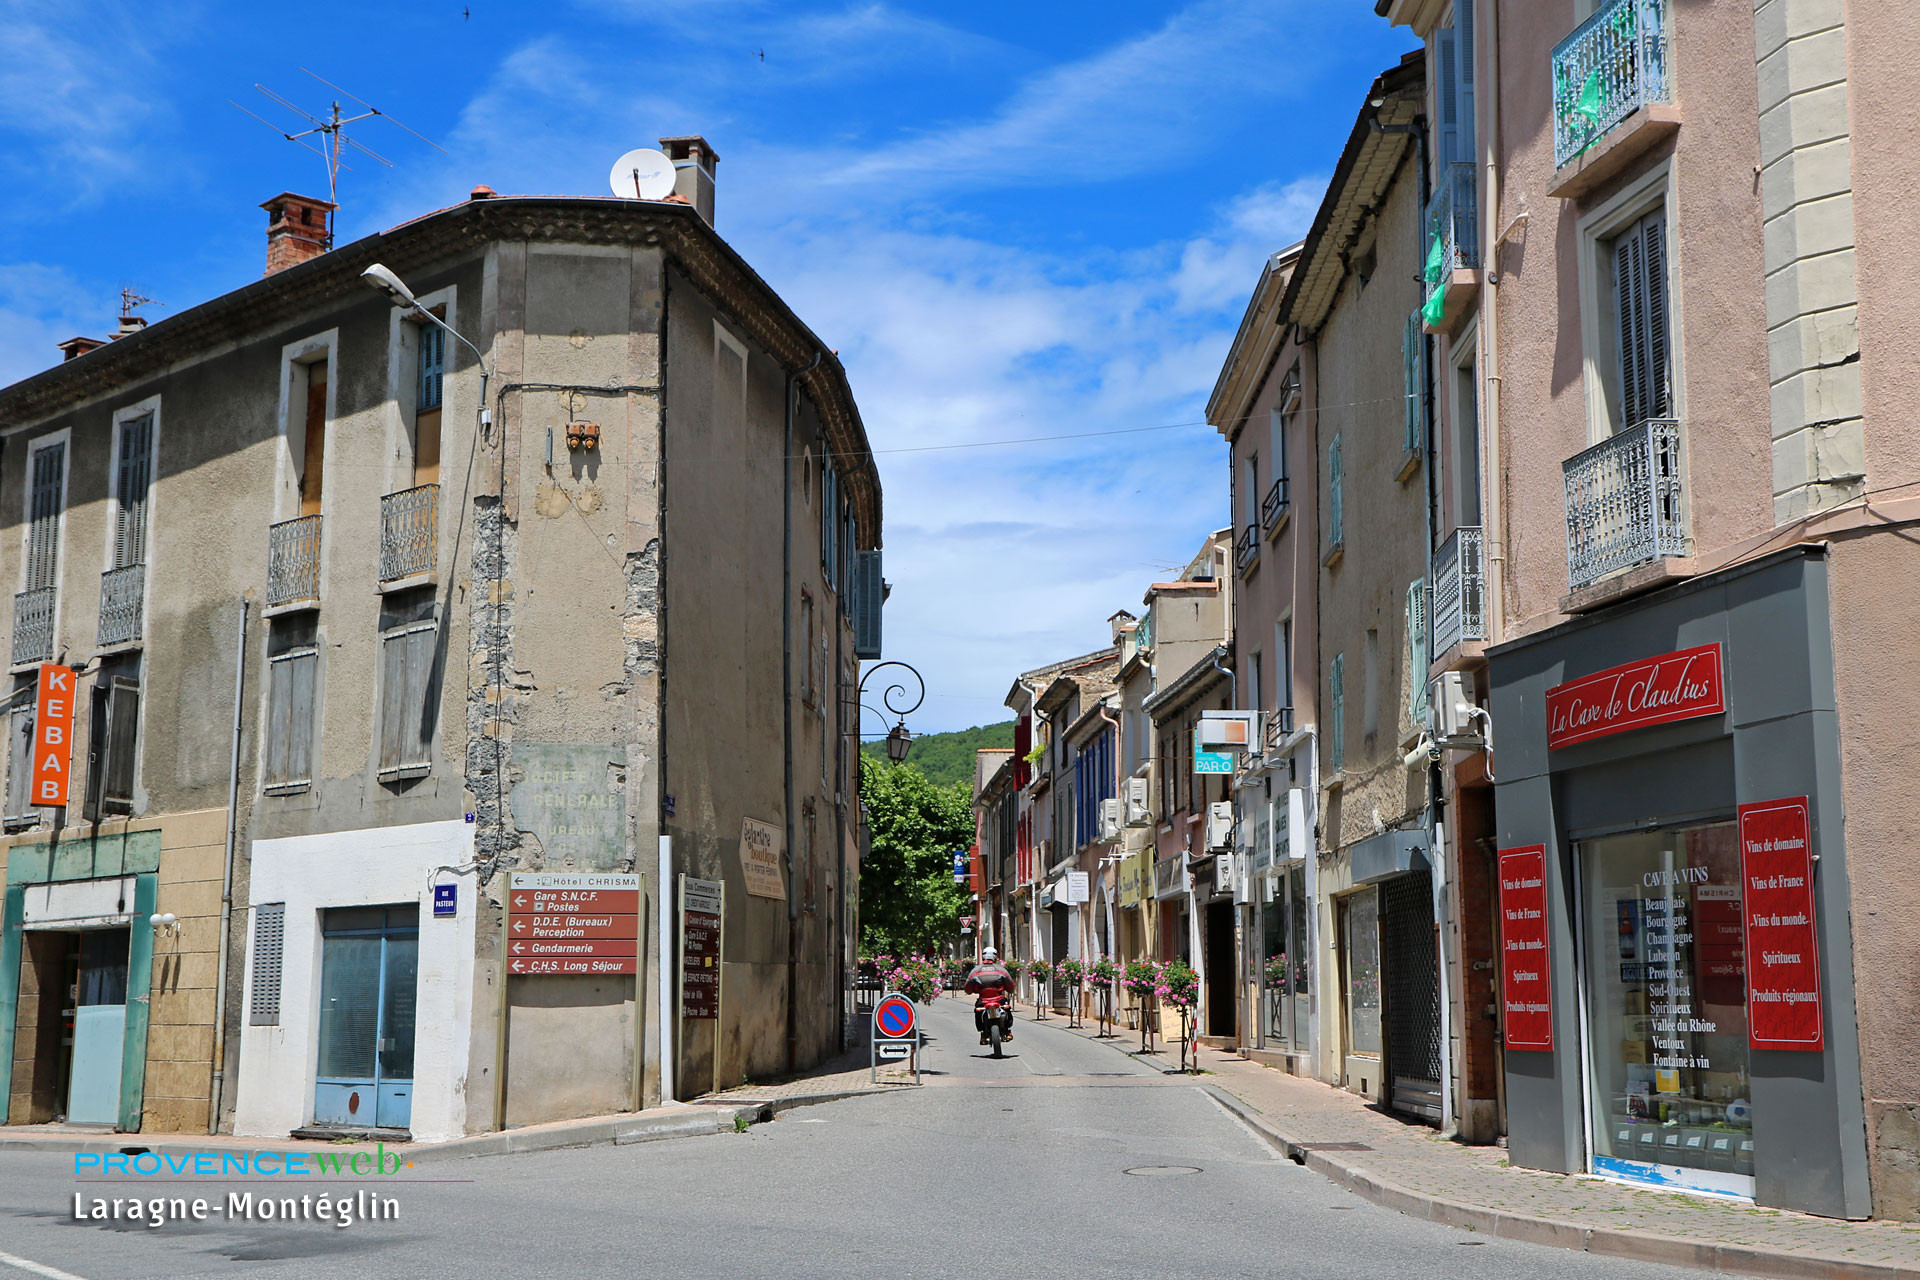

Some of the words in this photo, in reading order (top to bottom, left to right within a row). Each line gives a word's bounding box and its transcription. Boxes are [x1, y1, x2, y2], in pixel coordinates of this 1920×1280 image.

[1551, 705, 1567, 734] La
[1569, 698, 1602, 728] Cave
[1604, 673, 1625, 720] de
[1628, 655, 1709, 713] Claudius
[41, 672, 67, 799] KEBAB
[525, 771, 587, 783] OCIETE
[534, 795, 617, 807] GENERALE
[540, 825, 595, 835] BUREAU
[1746, 840, 1763, 854] Vins
[1764, 838, 1773, 851] de
[1773, 837, 1804, 850] domaine
[751, 848, 778, 866] boutique
[553, 877, 582, 886] Hôtel
[588, 878, 637, 886] CHRISMA
[1503, 879, 1514, 890] Vins
[1515, 878, 1521, 889] de
[1521, 876, 1542, 888] domaine
[1643, 871, 1668, 887] CAVE
[1672, 871, 1680, 885] A
[1681, 866, 1709, 883] VINS
[1750, 876, 1767, 890] Vins
[1768, 876, 1777, 888] de
[1778, 875, 1804, 888] France
[533, 891, 557, 901] Gare
[561, 892, 598, 901] S.N.C.F.
[547, 902, 579, 911] Postes
[1645, 895, 1686, 913] Beaujolais
[532, 917, 561, 926] D.D.E.
[565, 916, 613, 927] (Bureaux)
[1506, 909, 1517, 921] Vins
[1518, 909, 1524, 919] de
[1524, 908, 1541, 919] France
[1752, 914, 1770, 927] Vins
[1771, 913, 1781, 926] du
[1781, 912, 1806, 925] monde
[1646, 915, 1688, 930] Bourgogne
[532, 927, 584, 938] Perception
[1646, 931, 1693, 946] Champagne
[532, 944, 594, 953] Gendarmerie
[1507, 940, 1518, 951] Vins
[1519, 939, 1525, 950] du
[1526, 938, 1542, 949] monde
[1648, 949, 1680, 963] Luberon
[1762, 951, 1801, 968] Spiritueux
[531, 961, 560, 971] C.H.S.
[564, 961, 588, 972] Long
[592, 961, 623, 972] Séjour
[1648, 966, 1684, 979] Provence
[1513, 970, 1538, 983] Spiritueux
[1649, 983, 1691, 997] Sud-Ouest
[1752, 989, 1781, 1002] Produits
[1782, 989, 1817, 1005] régionaux
[1506, 1001, 1526, 1012] Produits
[1526, 1001, 1548, 1014] régionaux
[1650, 1001, 1691, 1017] Spiritueux
[1651, 1018, 1676, 1032] Vallée
[1677, 1019, 1688, 1032] du
[1689, 1018, 1717, 1033] Rhône
[1652, 1035, 1685, 1050] Ventoux
[1653, 1053, 1688, 1068] Fontaine
[1689, 1054, 1695, 1068] à
[1696, 1055, 1710, 1068] vin
